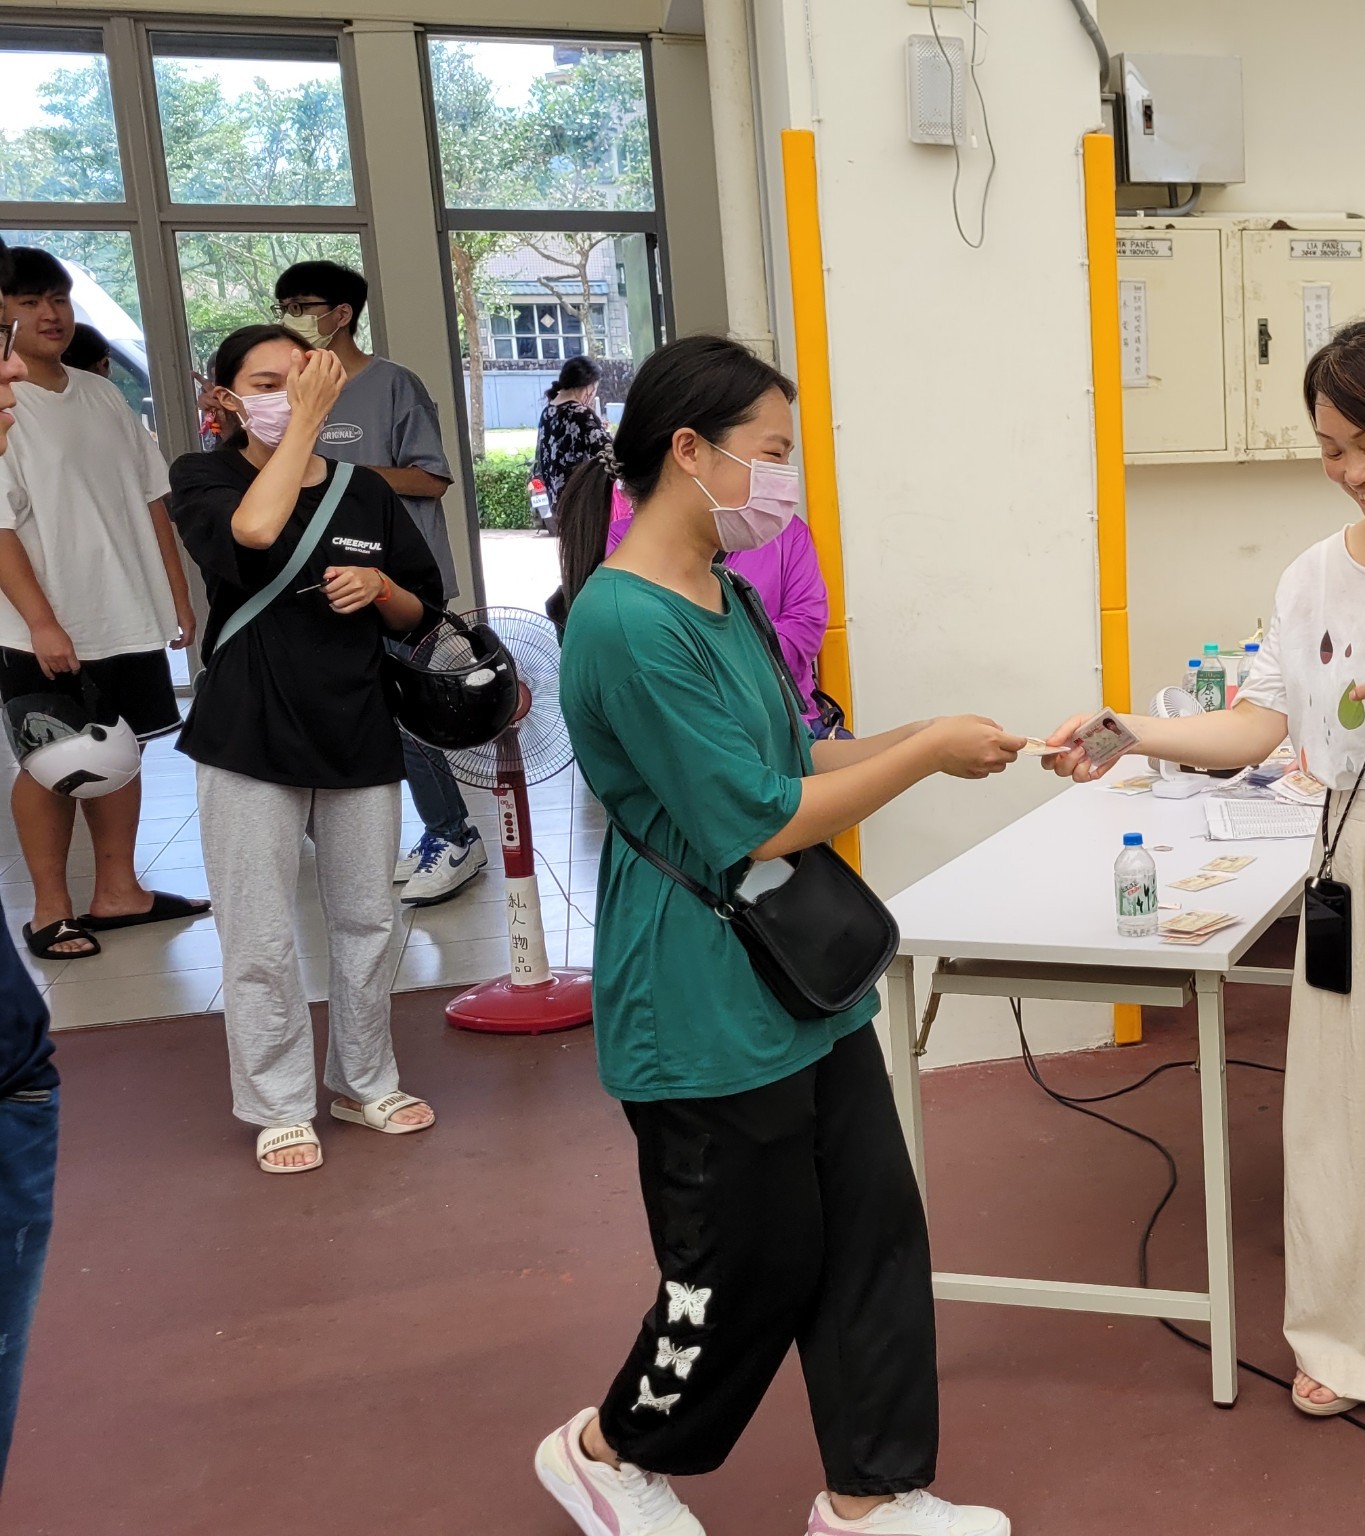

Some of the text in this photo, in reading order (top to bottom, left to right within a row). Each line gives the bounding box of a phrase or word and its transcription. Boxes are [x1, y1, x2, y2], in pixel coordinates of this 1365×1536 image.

[1321, 242, 1344, 250] PANEL
[332, 537, 382, 550] CHEERFUL
[508, 892, 532, 973] 私人物品
[263, 1130, 304, 1150] PUMA
